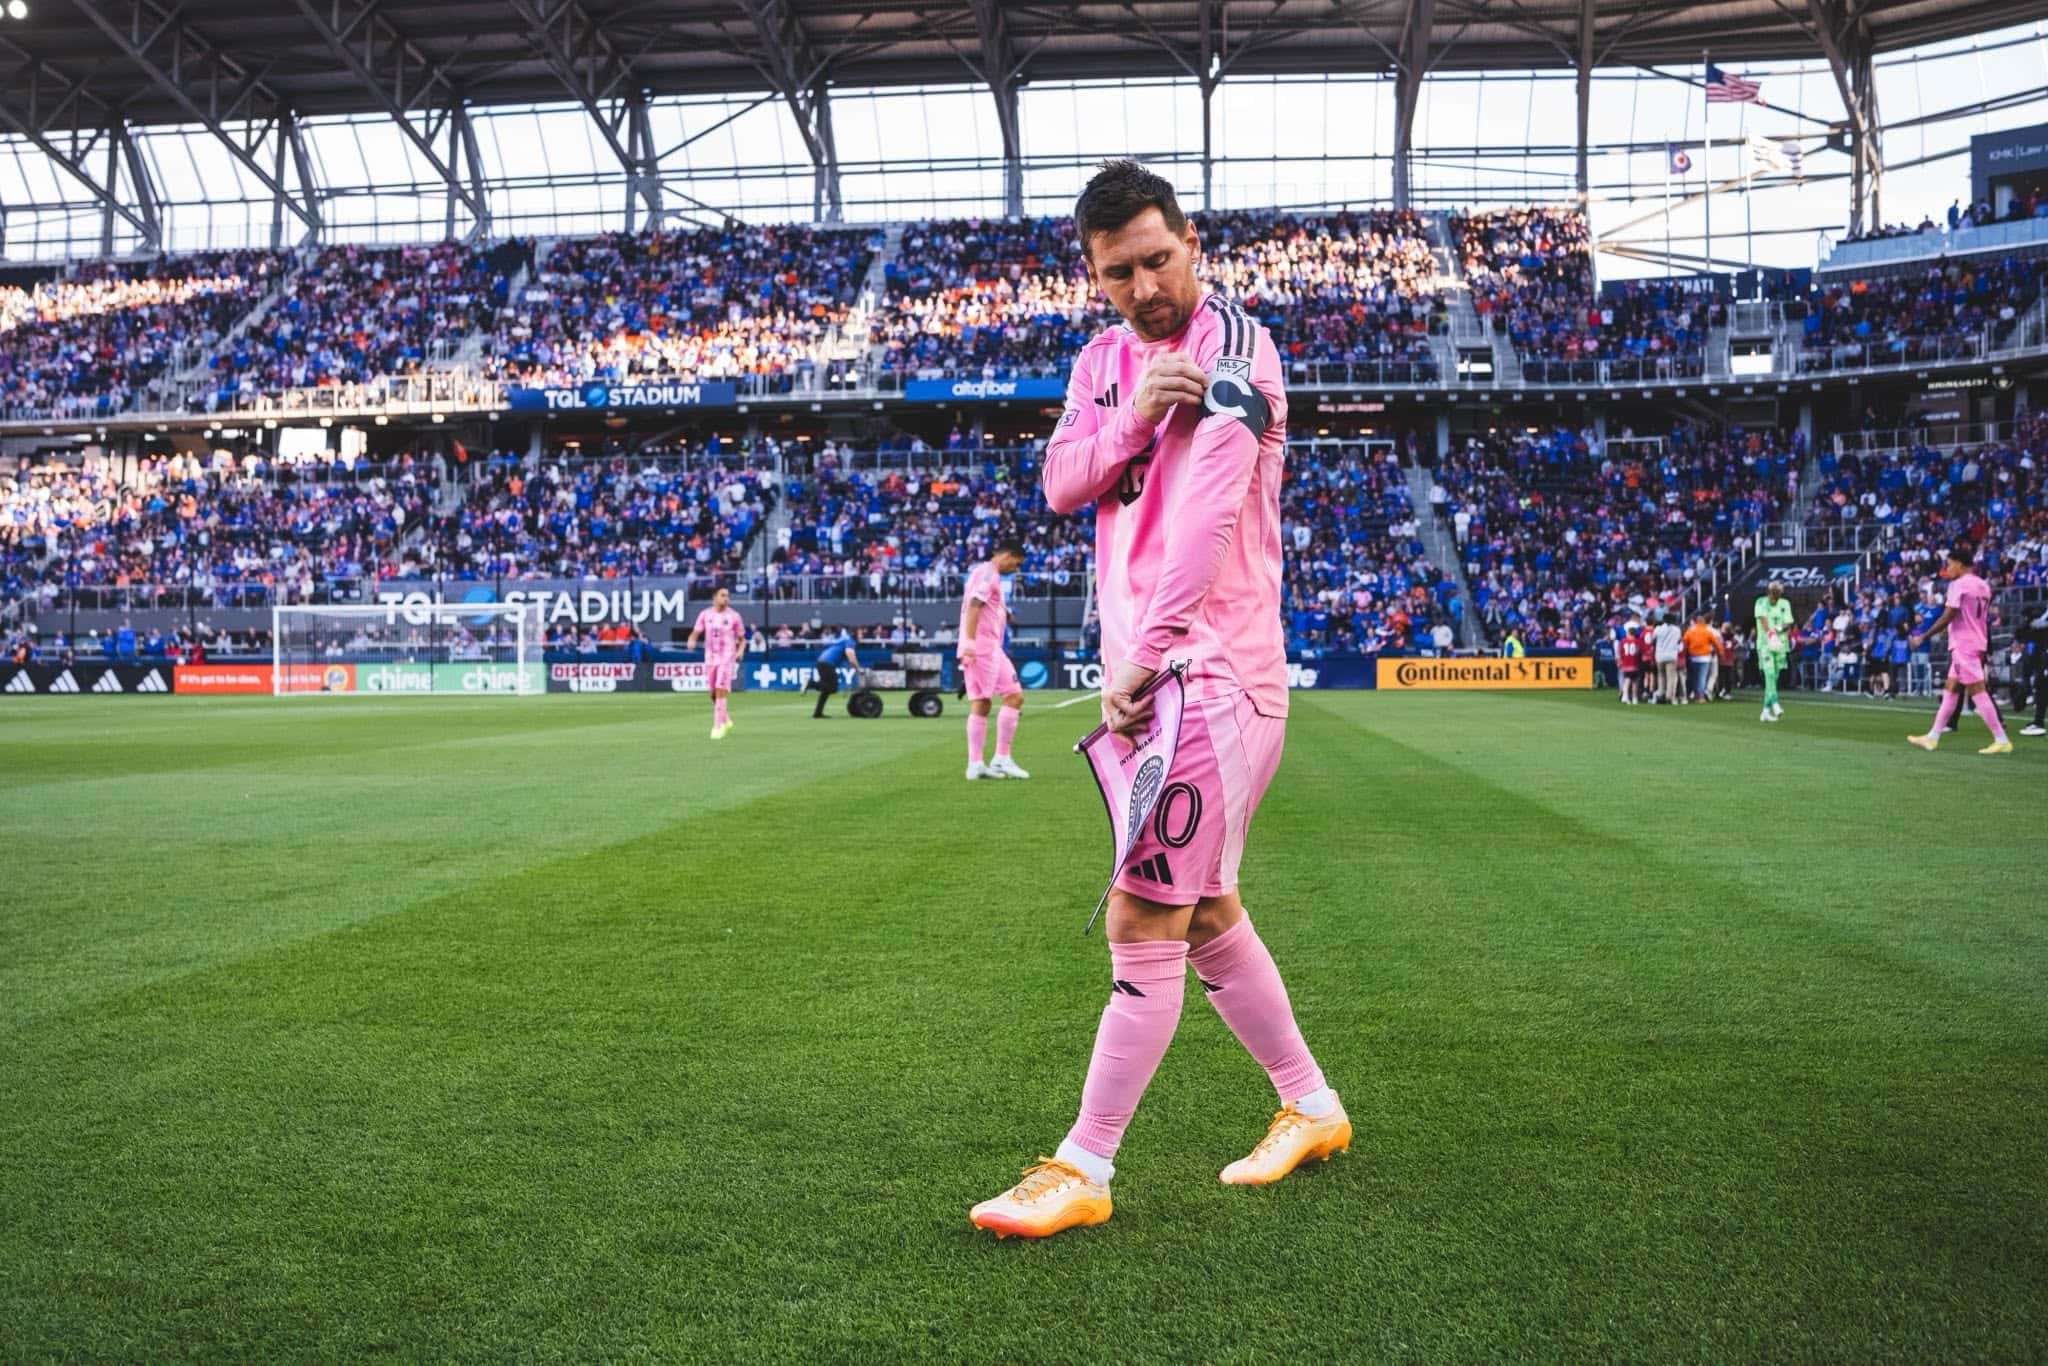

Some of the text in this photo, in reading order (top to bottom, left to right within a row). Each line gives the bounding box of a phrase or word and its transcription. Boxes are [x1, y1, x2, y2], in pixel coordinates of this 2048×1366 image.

[1219, 361, 1238, 369] MLS
[544, 386, 701, 409] TQL STADIUM
[1204, 374, 1253, 417] C
[1768, 566, 1824, 580] TQL
[379, 588, 685, 625] TQL STADIUM
[367, 666, 431, 690] chime
[554, 662, 634, 678] DISCOUNT
[656, 662, 703, 678] DISCO
[1063, 663, 1105, 689] TQ
[1396, 661, 1577, 686] Continental Tire
[1138, 782, 1203, 848] 0
